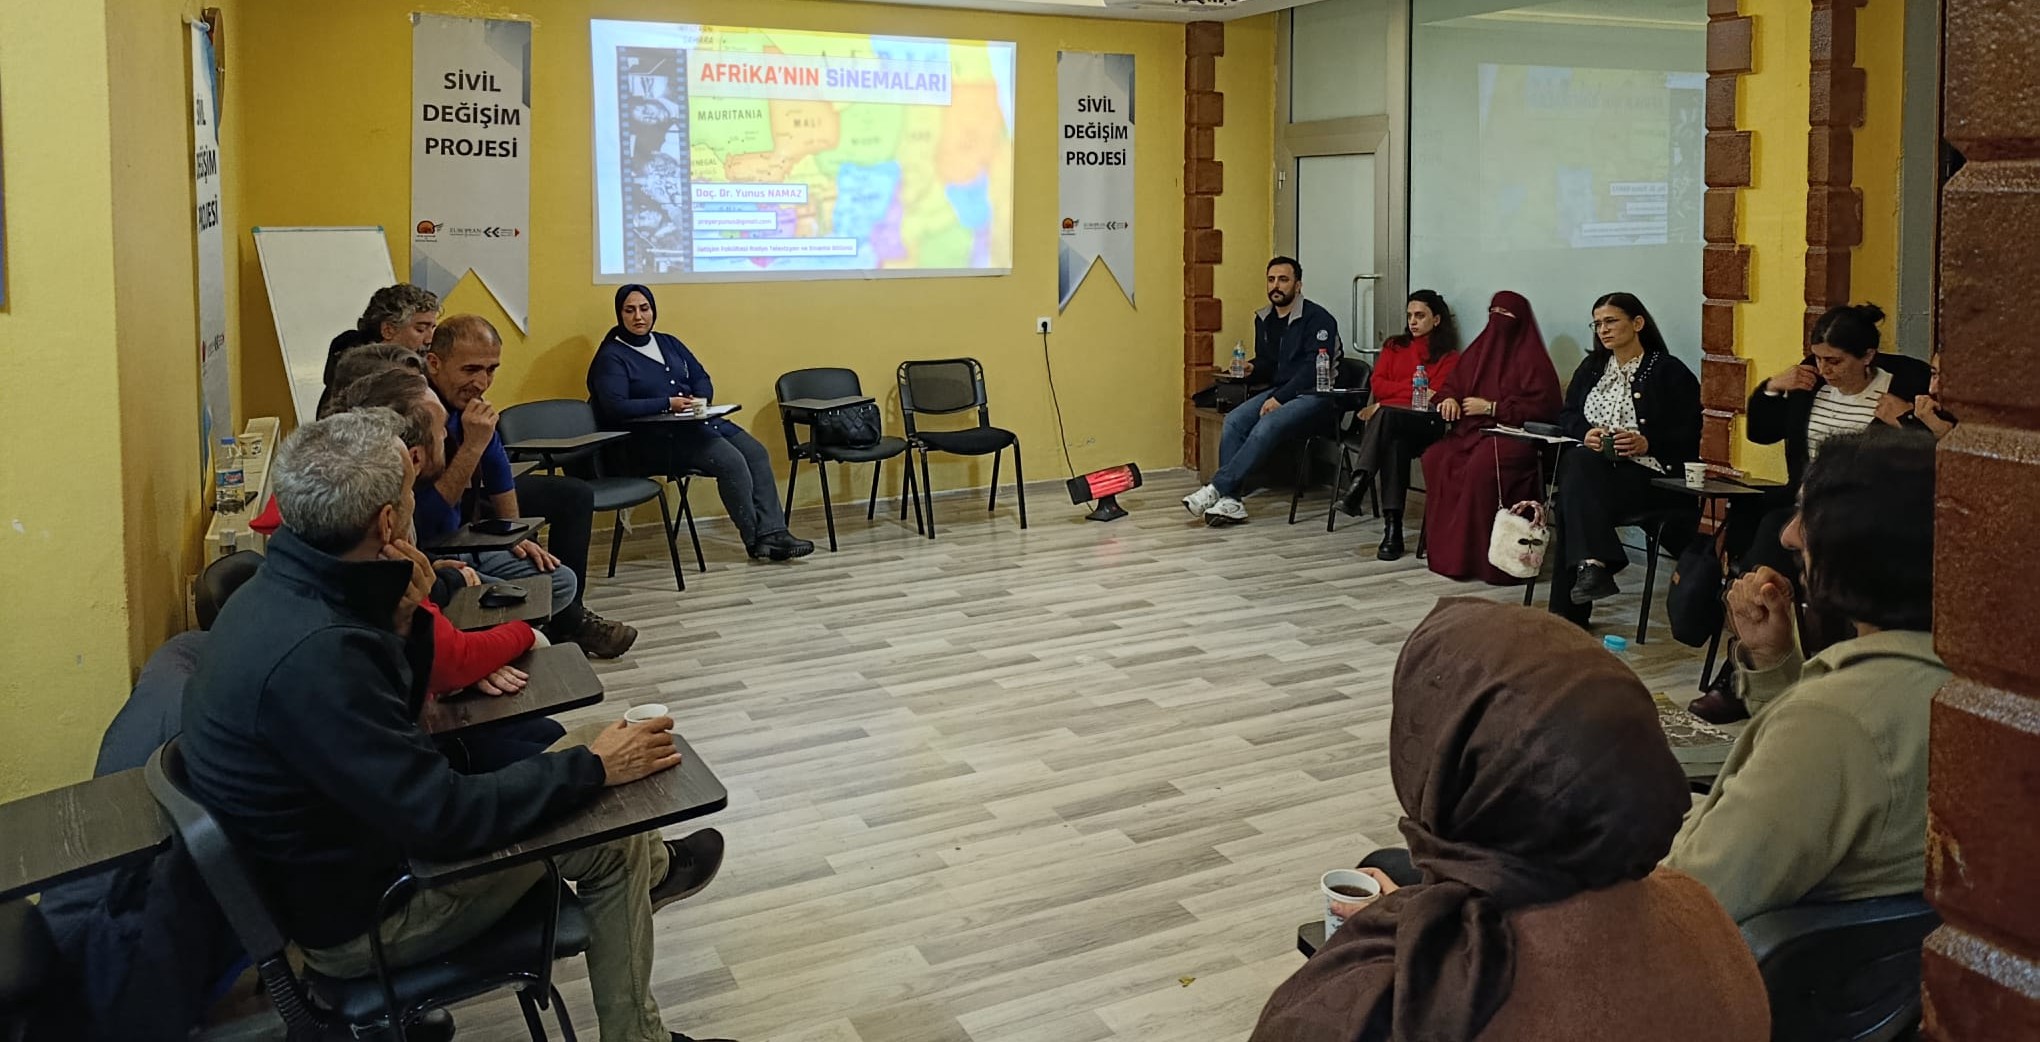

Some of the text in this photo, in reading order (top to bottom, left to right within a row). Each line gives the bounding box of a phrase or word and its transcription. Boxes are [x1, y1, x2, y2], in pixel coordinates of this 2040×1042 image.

[444, 69, 501, 93] SİVİL
[1078, 95, 1116, 113] SİVİL
[422, 102, 521, 129] DEĞİŞİM
[697, 109, 763, 121] MAURITANIA
[1064, 122, 1128, 142] DEĞİŞİM
[425, 137, 517, 158] PROJESİ
[1066, 149, 1126, 166] PROJESİ
[696, 188, 802, 199] Doç. Dr. Yunus NAMAZ
